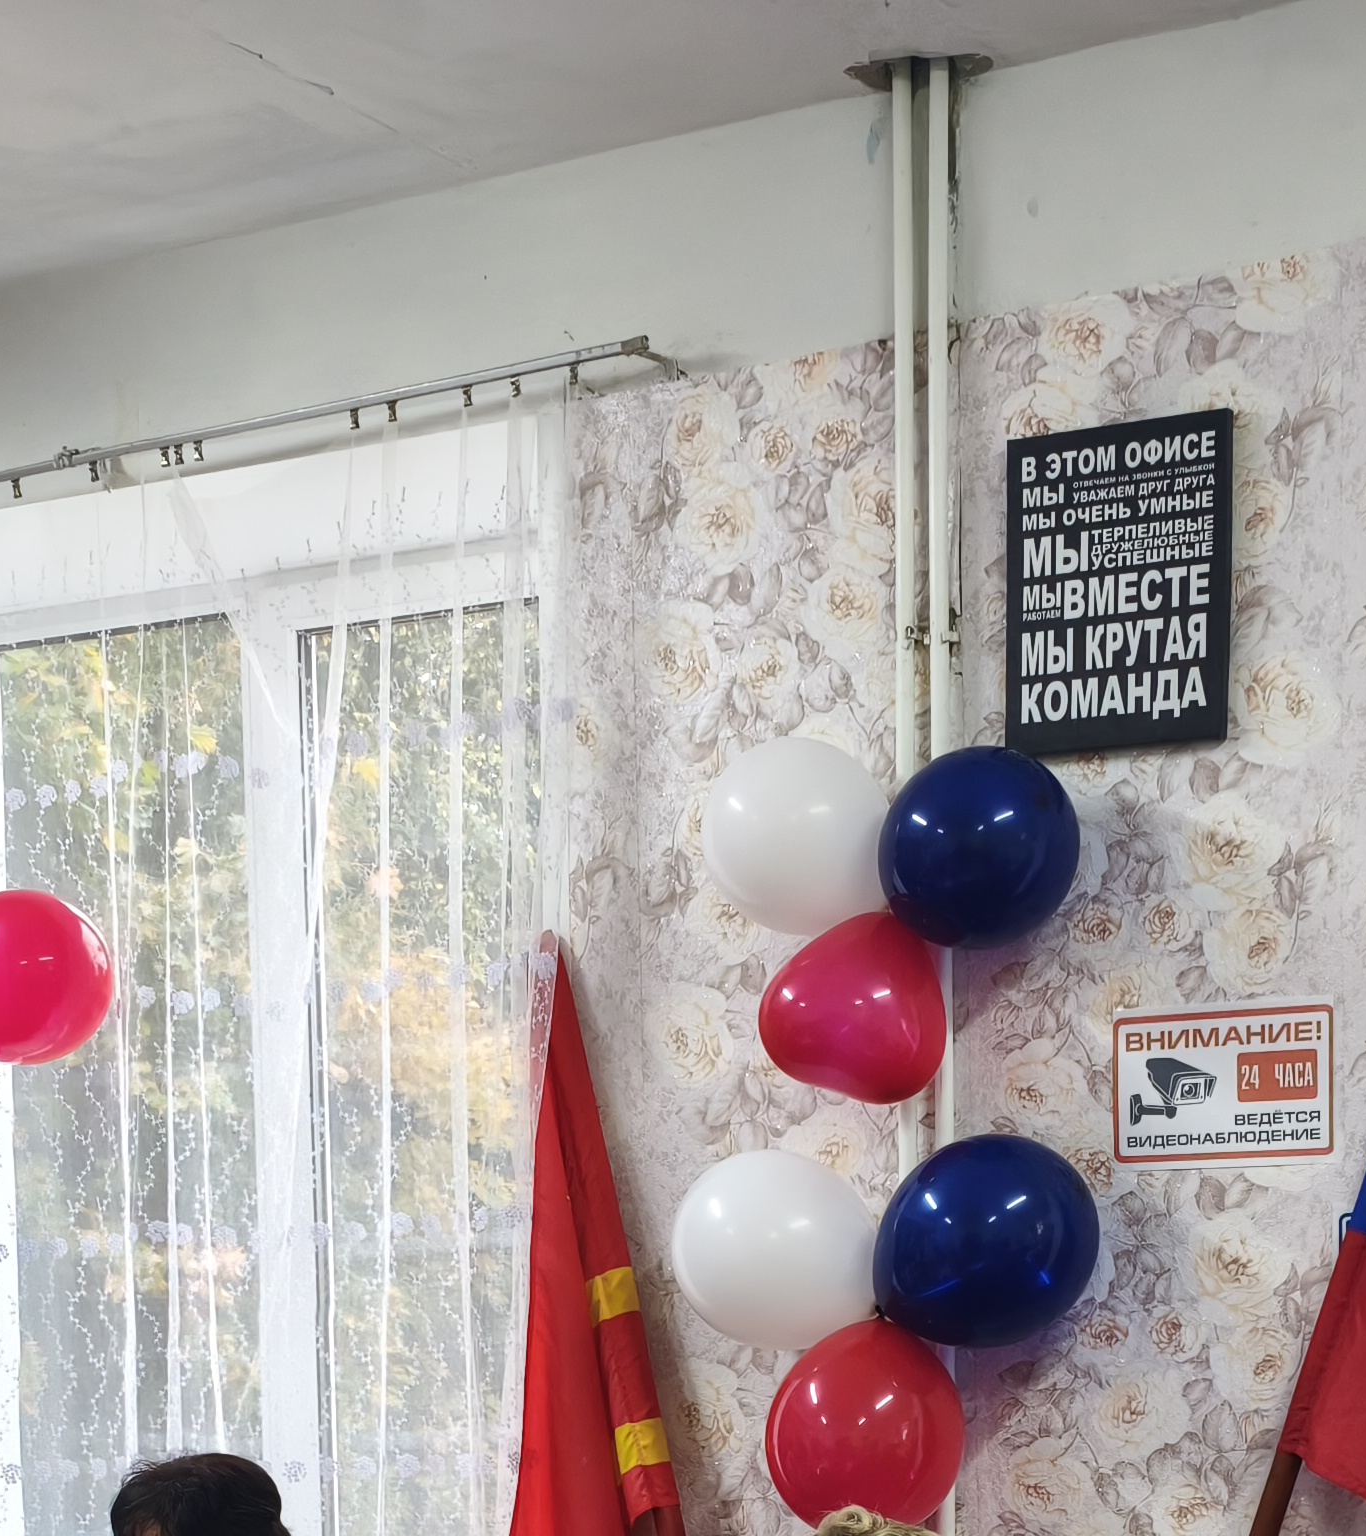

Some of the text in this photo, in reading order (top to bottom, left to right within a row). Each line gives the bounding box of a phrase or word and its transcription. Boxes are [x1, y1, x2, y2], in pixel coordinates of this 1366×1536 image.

[1021, 430, 1216, 483] В ЭТОМ ОФИСЕ
[1022, 484, 1065, 509] МЫ
[1073, 477, 1116, 489] ОТВЕЧАЕМ
[1073, 473, 1215, 504] УВАЖАЕМ ДРУГ ДРУГА
[1022, 490, 1214, 532] МЫ ОЧЕНЬ УМНЫЕ
[1091, 514, 1214, 544] ТЕРПЕЛИВЫЕ
[1091, 530, 1214, 556] ДРУЖЕЛЮБНЫЕ
[1023, 530, 1089, 579] МЫ
[1091, 541, 1214, 570] УСПЕШНЫЕ
[1023, 563, 1211, 621] МЫ ВМЕСТЕ
[1022, 608, 1062, 622] РАБОТАЕМ
[1021, 612, 1208, 678] МЫ КРУТАЯ
[1021, 666, 1207, 725] КОМАНДА
[1125, 1020, 1322, 1053] ВНИМАНИЕ!
[1241, 1061, 1314, 1090] 24 ЧАСА
[1234, 1109, 1321, 1127] ВЕДЁТСЯ
[1127, 1128, 1321, 1149] ВИДЕОНАБЛЮДЕНИЕ
